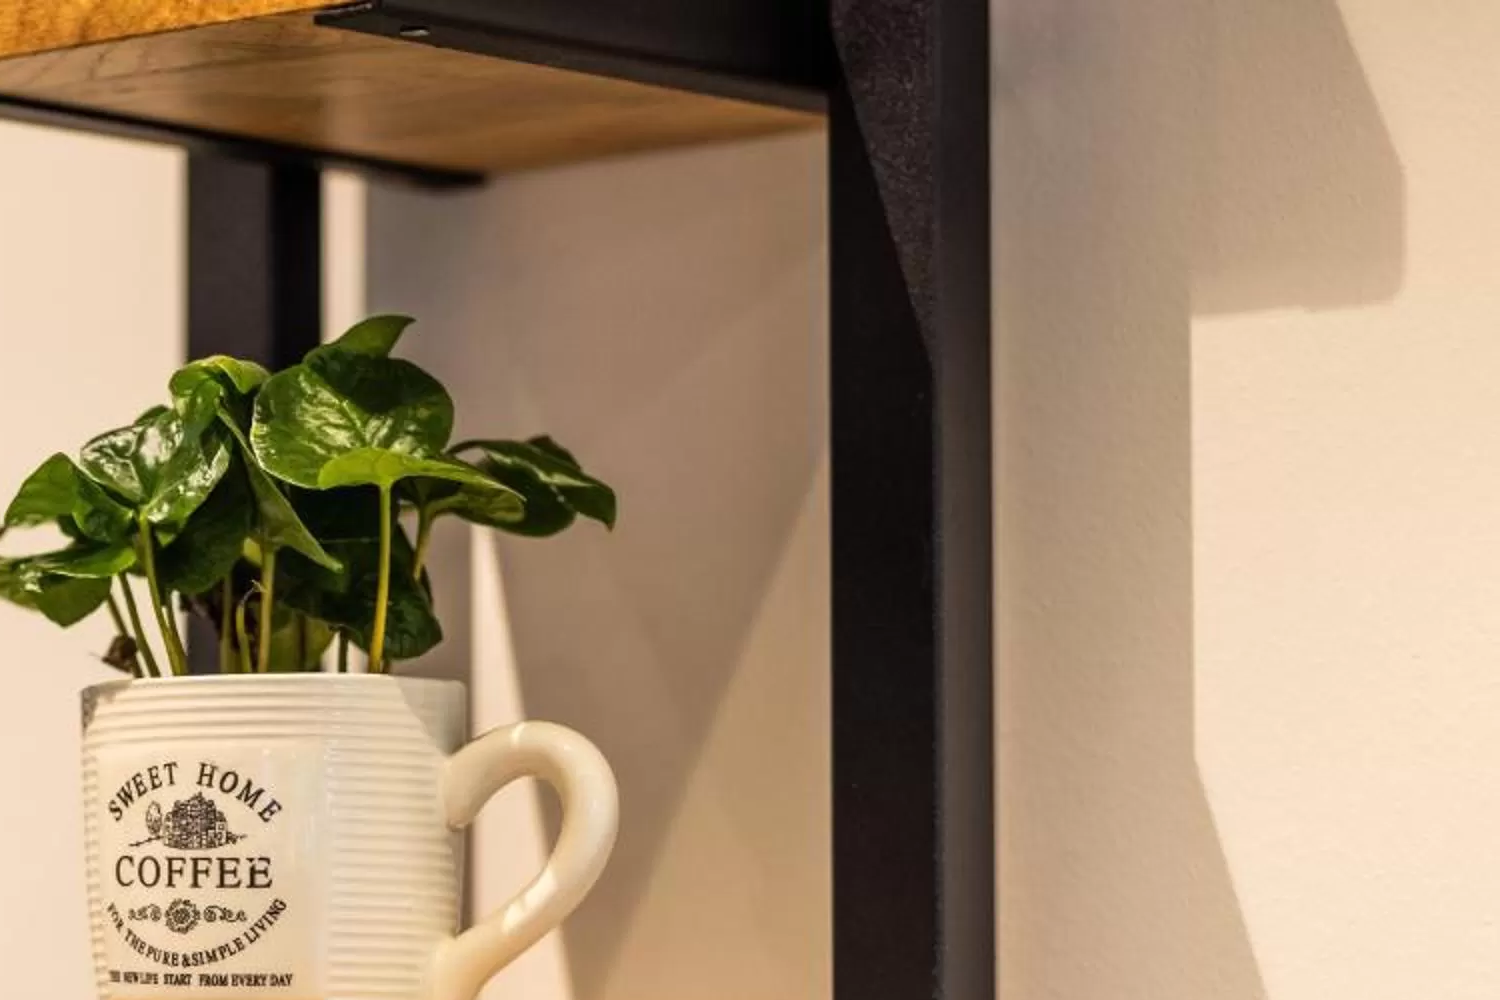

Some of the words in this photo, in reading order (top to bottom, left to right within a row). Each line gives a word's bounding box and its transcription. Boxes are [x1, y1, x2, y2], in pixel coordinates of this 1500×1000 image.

[108, 761, 178, 821] SWEET
[196, 762, 283, 822] HOME
[115, 855, 273, 889] COFFEE
[243, 899, 287, 944] LIVING
[163, 973, 192, 986] START
[199, 973, 228, 987] FROM
[231, 973, 267, 987] EVERY
[269, 973, 293, 987] DAY
